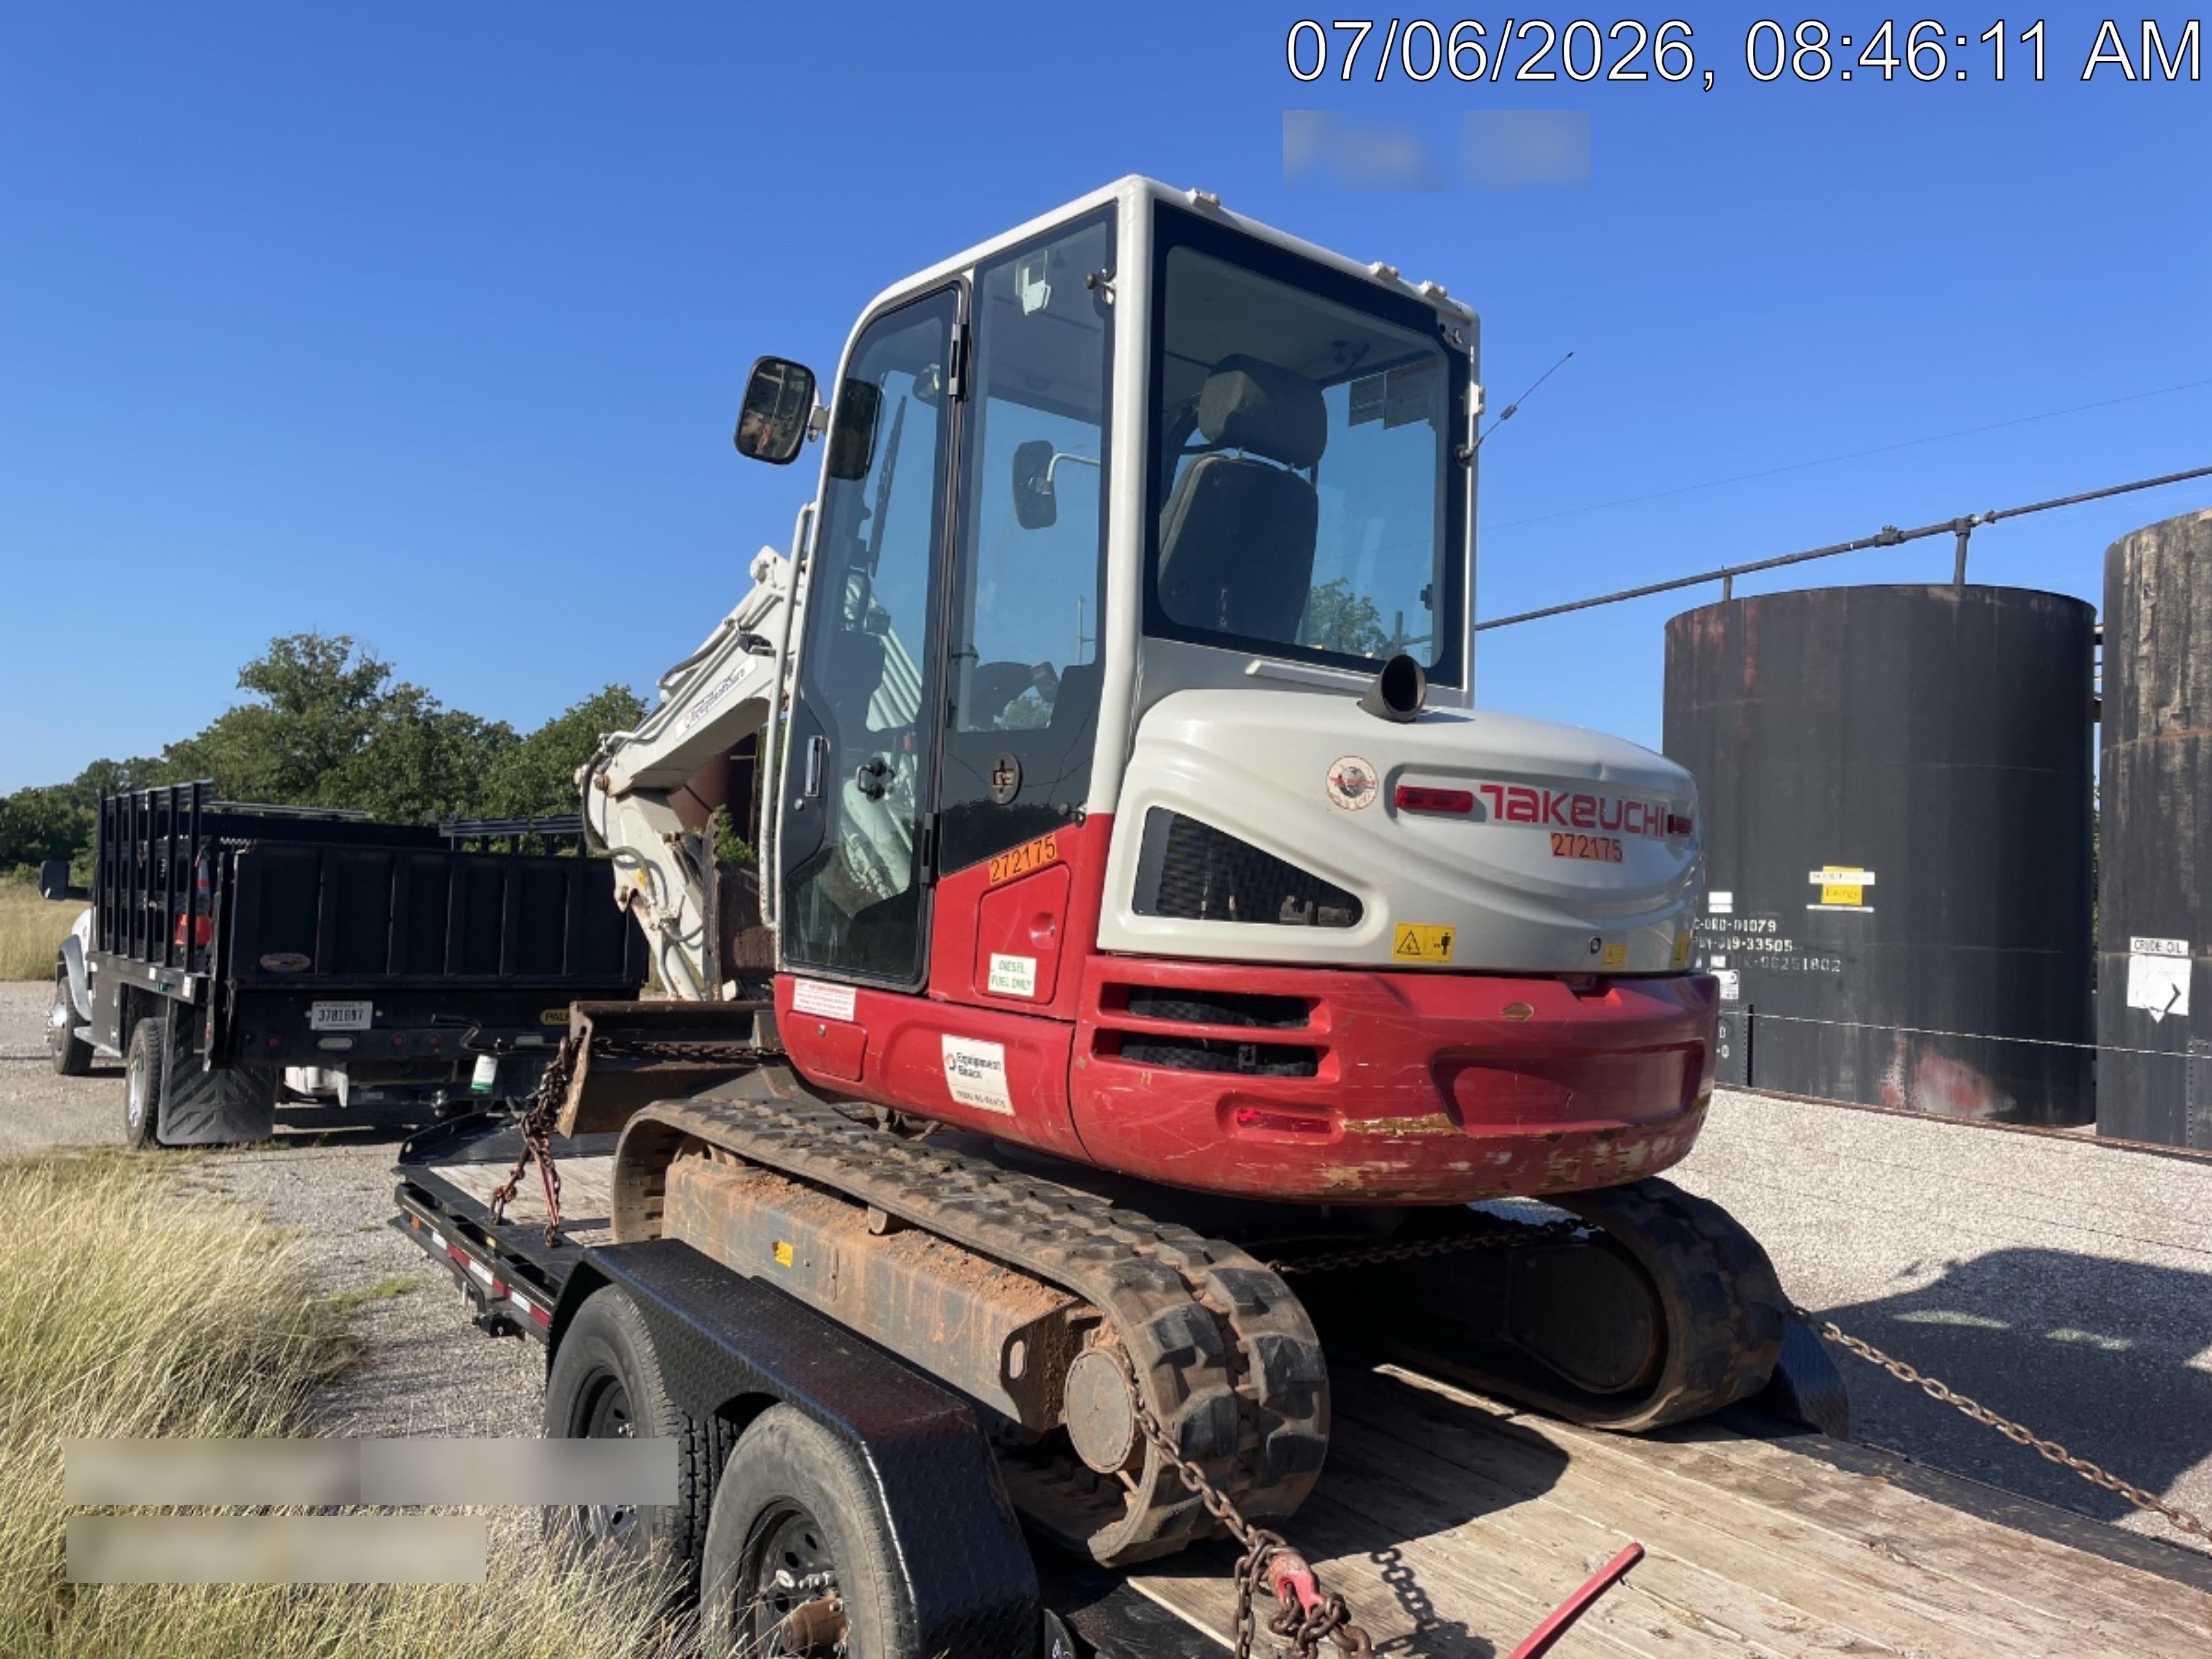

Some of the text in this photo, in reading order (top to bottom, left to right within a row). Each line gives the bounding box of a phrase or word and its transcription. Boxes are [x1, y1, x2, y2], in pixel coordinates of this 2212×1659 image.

[990, 834, 1055, 883] 272175
[1551, 833, 1623, 861] 272175
[2135, 939, 2183, 953] CRUDE OIL
